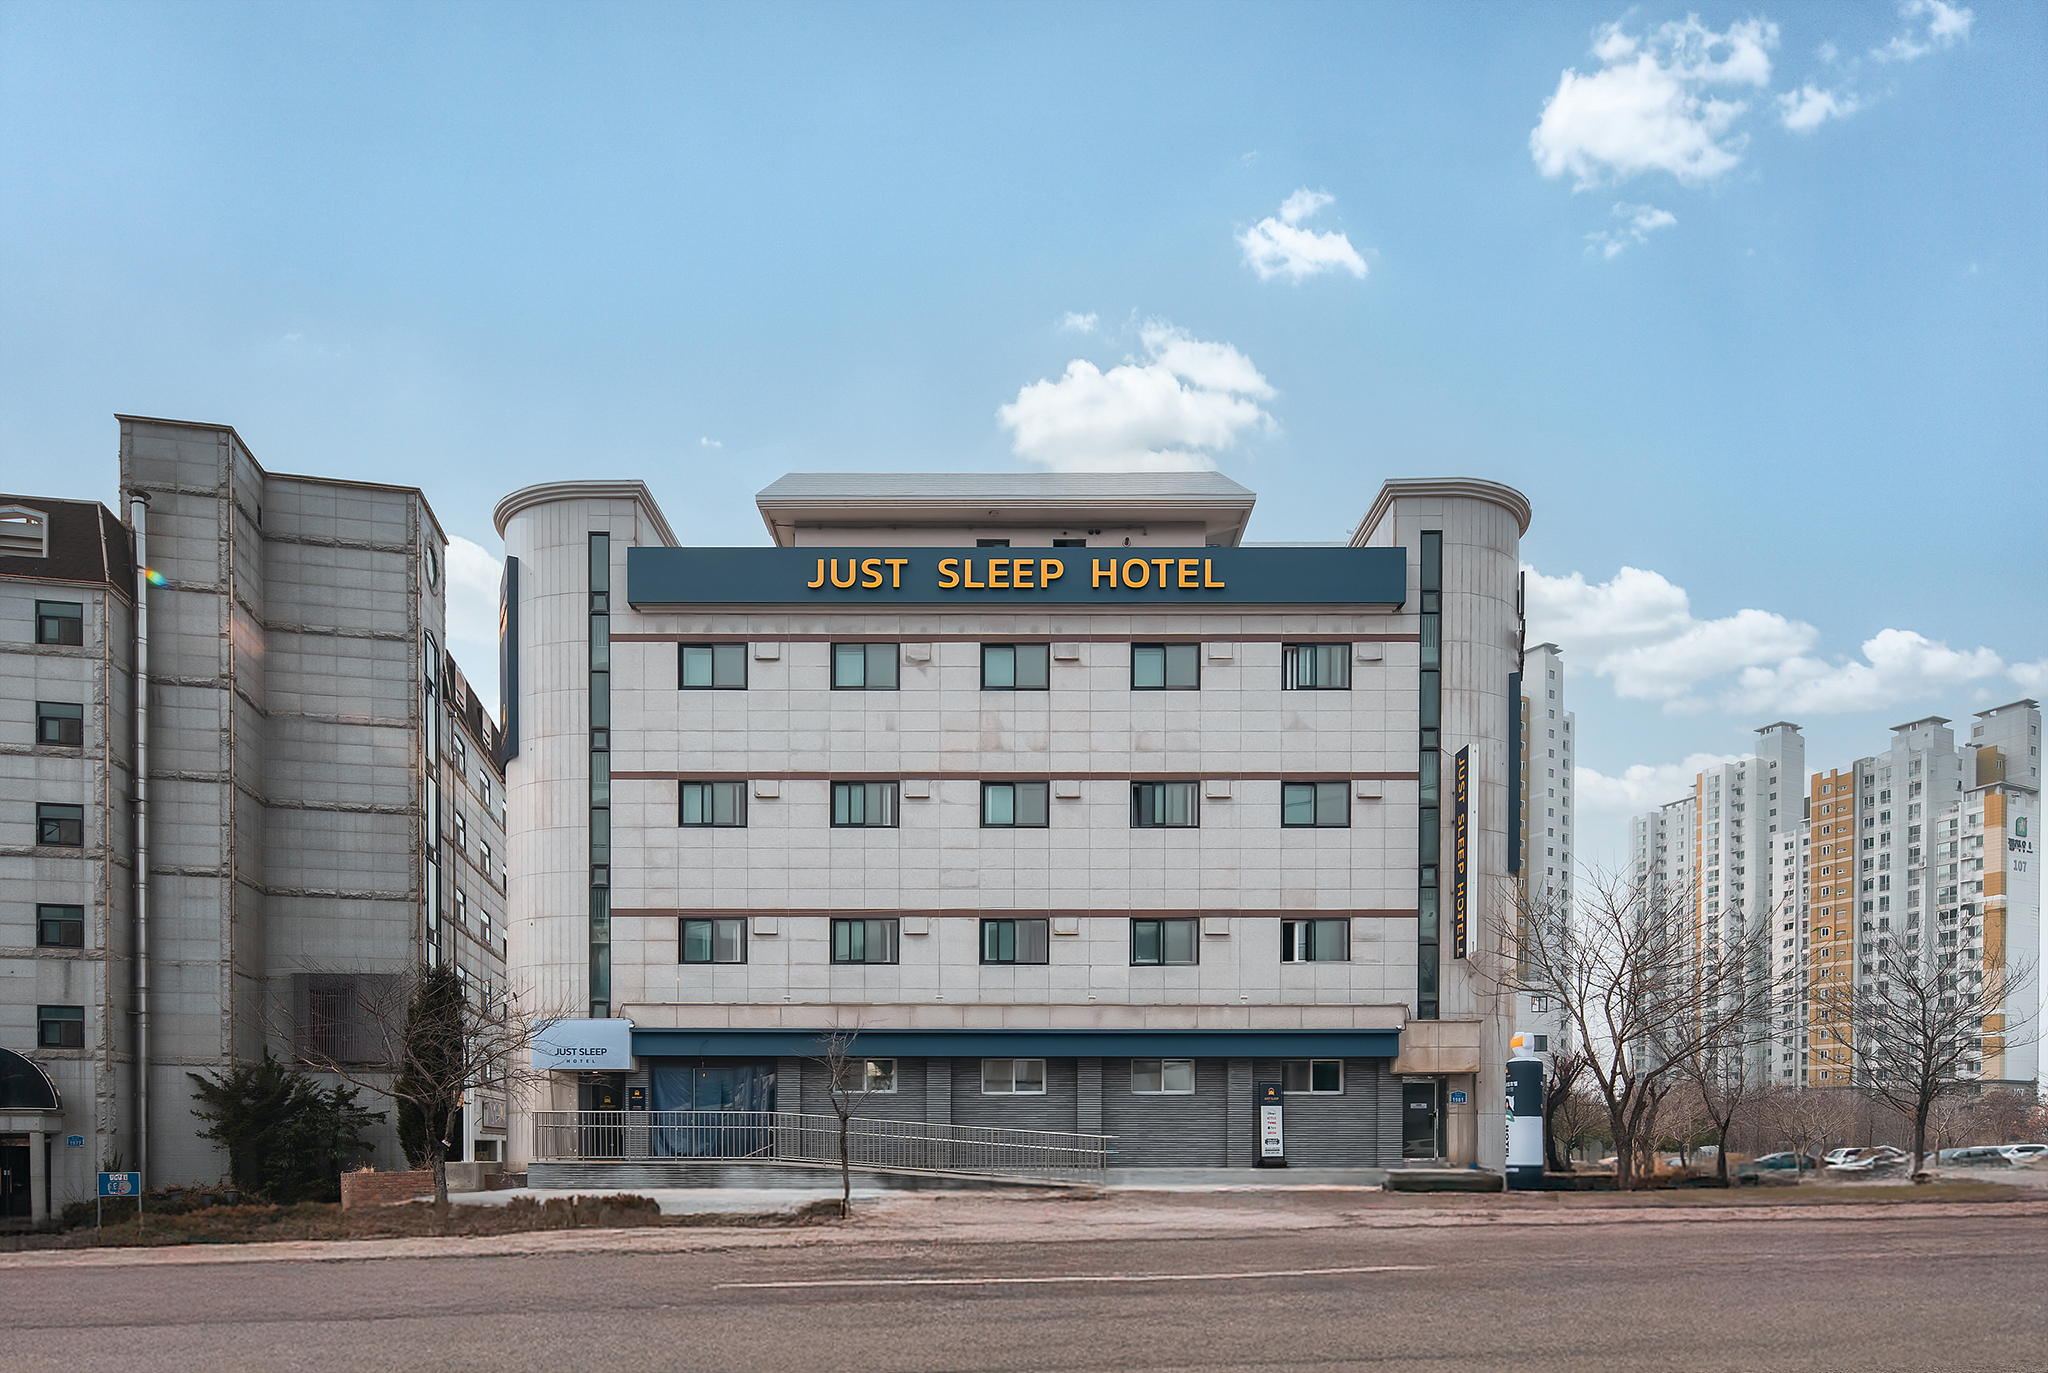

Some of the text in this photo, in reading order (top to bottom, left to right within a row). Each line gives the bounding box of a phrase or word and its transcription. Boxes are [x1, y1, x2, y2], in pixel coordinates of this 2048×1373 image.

[806, 558, 1225, 589] JUST SLEEP HOTEL
[1456, 757, 1466, 957] JUST SLEEP HOTEL
[2013, 859, 2027, 872] 107
[555, 1047, 607, 1056] JUST SLEEP
